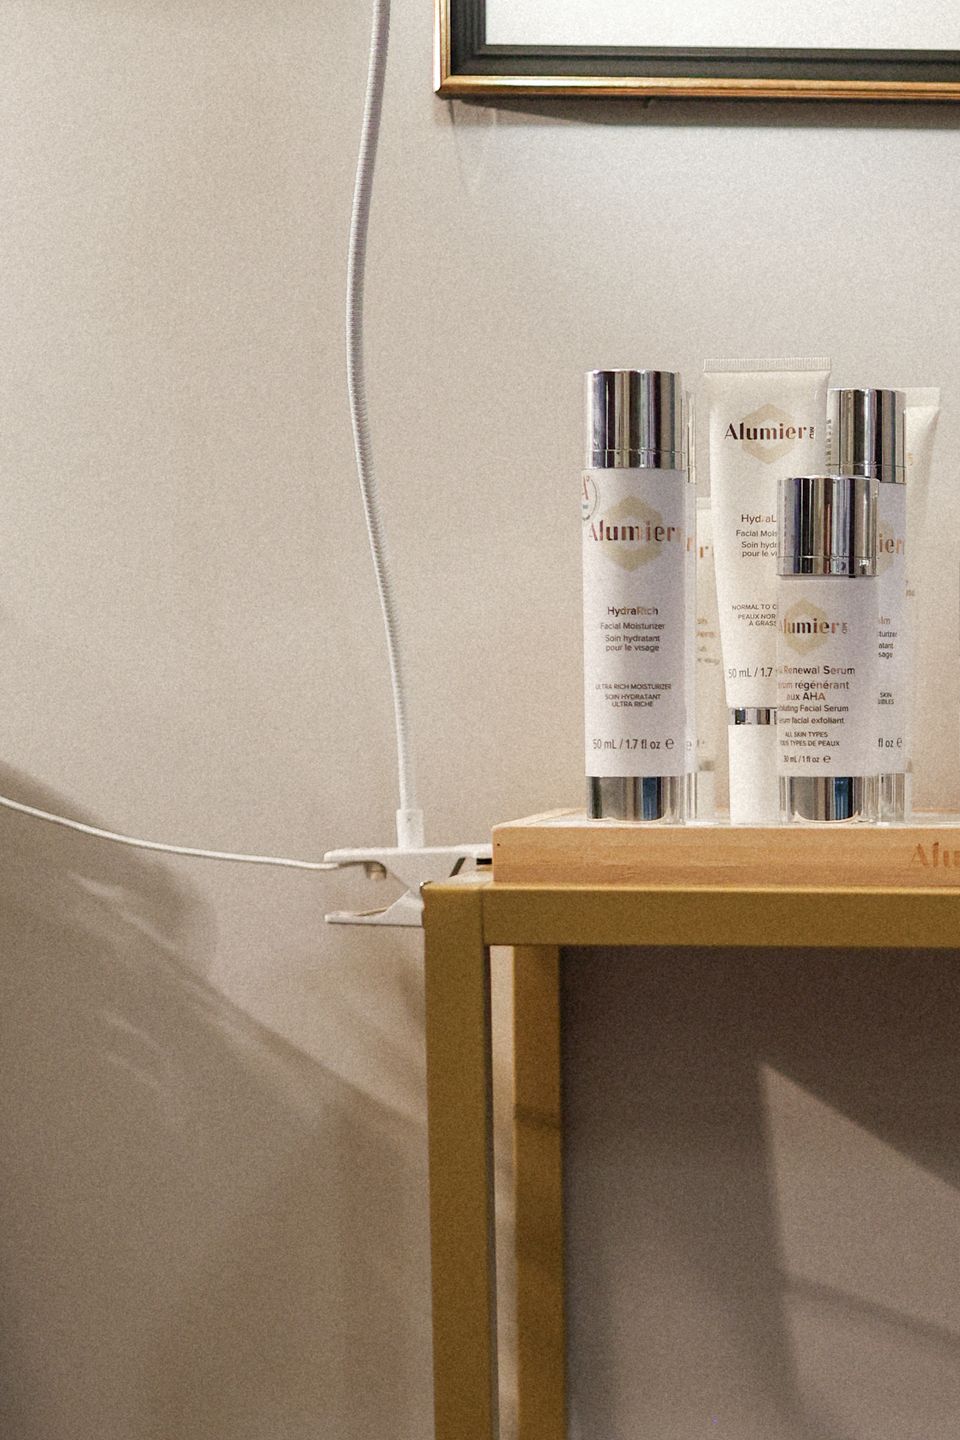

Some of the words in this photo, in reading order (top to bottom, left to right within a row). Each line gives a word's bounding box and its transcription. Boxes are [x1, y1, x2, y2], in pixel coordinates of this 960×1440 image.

[724, 422, 807, 440] Alumier
[590, 519, 676, 541] Alumier
[607, 606, 659, 617] HydraRich
[600, 622, 621, 630] Facial
[623, 622, 665, 630] Moisturizer
[623, 635, 660, 643] hydratant
[729, 669, 737, 678] 50
[739, 668, 751, 677] mL
[761, 667, 773, 677] 1.7
[783, 666, 819, 675] Renewal
[823, 666, 855, 675] Serum
[795, 681, 849, 691] régénérant
[800, 704, 821, 712] Facial
[823, 704, 849, 712] Serum
[593, 739, 601, 750] 50
[604, 739, 617, 750] mL
[626, 739, 638, 750] 1.7
[650, 739, 660, 750] oz
[886, 738, 894, 748] oz
